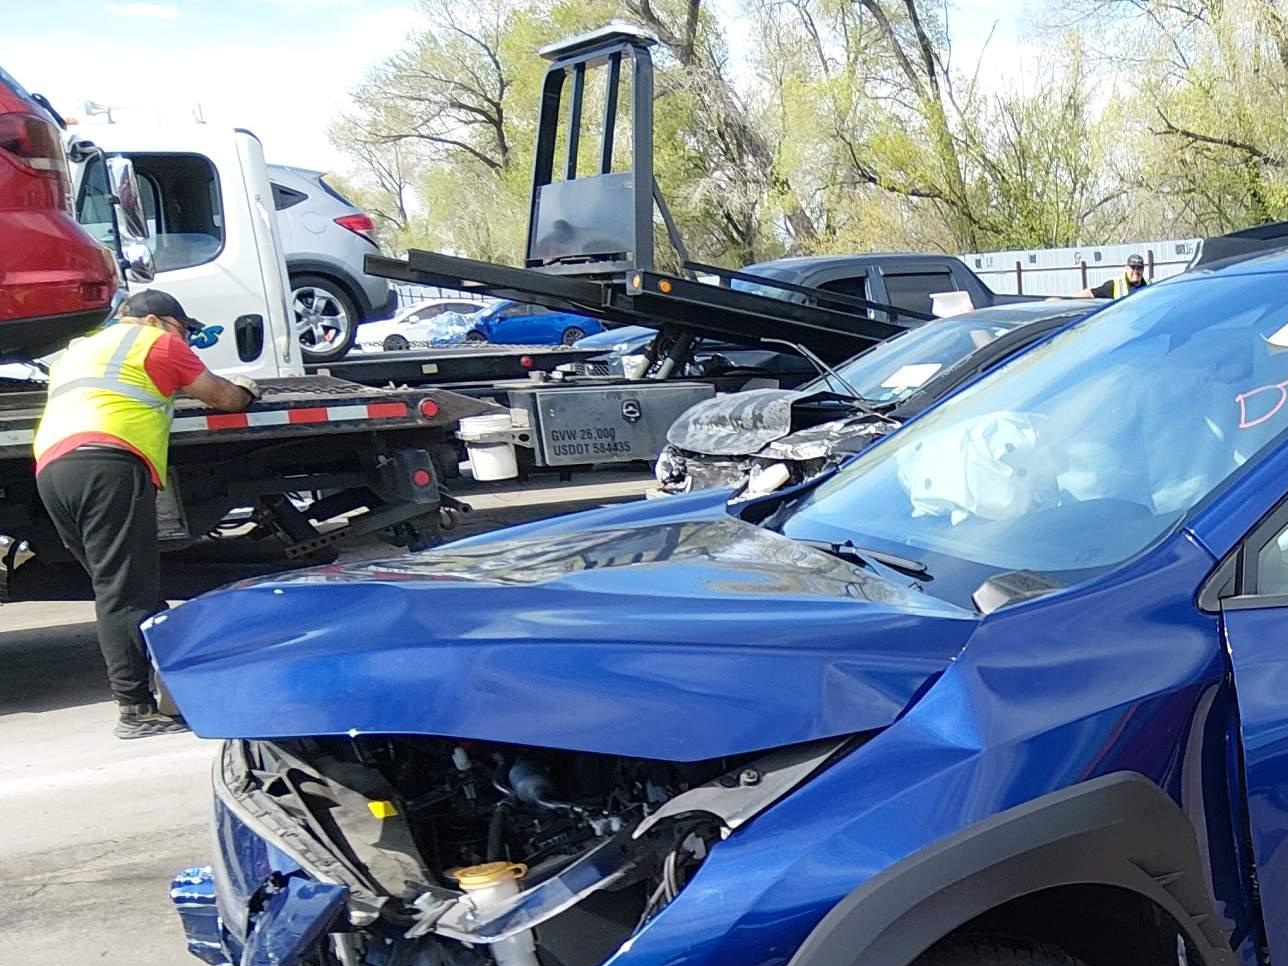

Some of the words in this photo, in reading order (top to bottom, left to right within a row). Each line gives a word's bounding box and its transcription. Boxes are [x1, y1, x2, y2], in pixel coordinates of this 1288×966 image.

[551, 429, 577, 441] GVW
[580, 427, 616, 441] 26,000
[553, 443, 590, 456] USDOT
